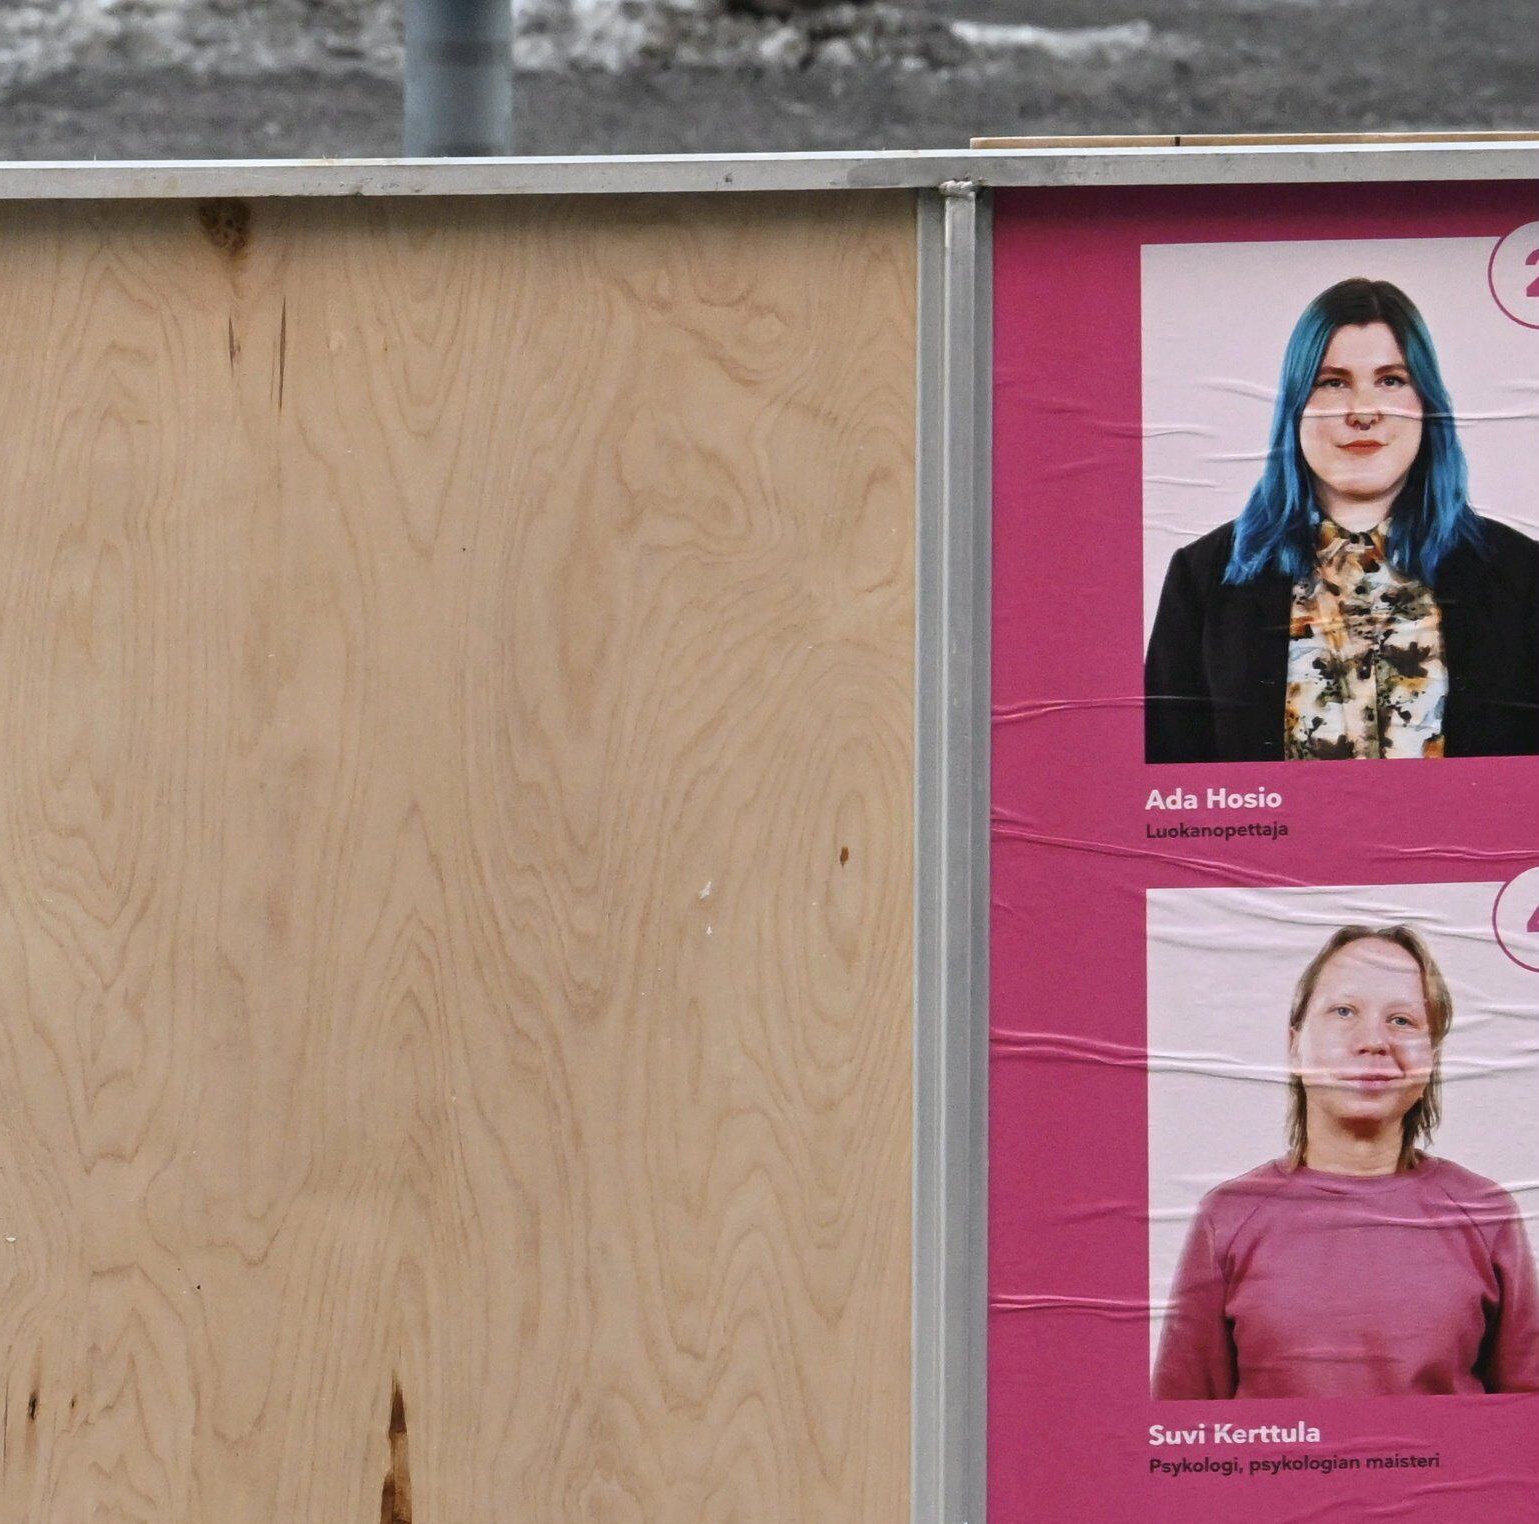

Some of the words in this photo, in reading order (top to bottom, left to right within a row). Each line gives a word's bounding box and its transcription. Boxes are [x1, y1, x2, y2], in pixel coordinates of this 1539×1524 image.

[1145, 788, 1198, 811] Ada
[1206, 787, 1283, 809] Hosio
[1146, 821, 1289, 841] Luokanopettaja
[1149, 1424, 1205, 1445] Suvi
[1214, 1421, 1320, 1444] Kerttula
[1150, 1456, 1243, 1477] Psykologi,
[1249, 1454, 1361, 1475] psykologian
[1366, 1453, 1440, 1469] maisteri
